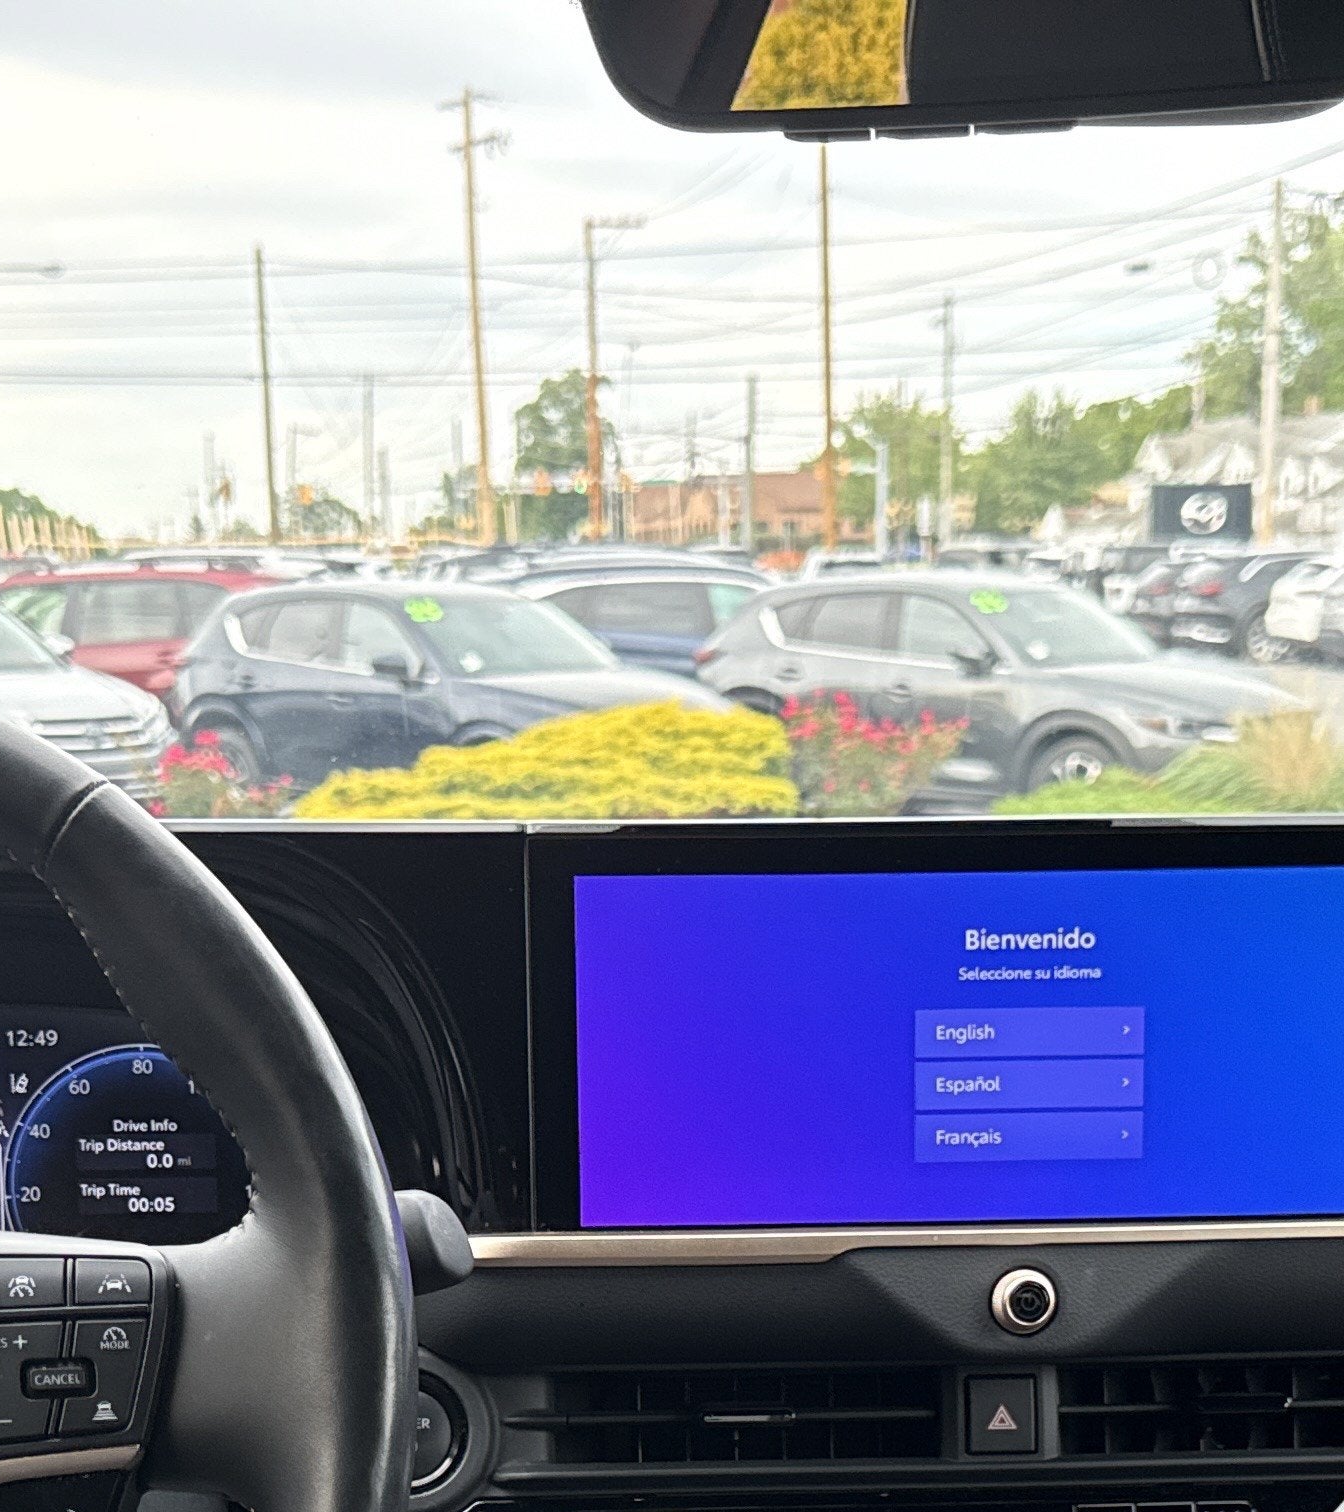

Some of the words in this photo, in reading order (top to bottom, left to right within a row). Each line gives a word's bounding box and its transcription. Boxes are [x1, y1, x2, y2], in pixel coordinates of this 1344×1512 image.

[965, 927, 1096, 951] Bienvenido
[958, 967, 1032, 981] Seleccione
[1035, 969, 1050, 980] su
[1053, 966, 1102, 980] idioma
[6, 1029, 58, 1047] 12:49
[936, 1024, 995, 1045] English
[132, 1059, 153, 1075] 80
[69, 1080, 91, 1095] 60
[936, 1076, 1001, 1096] Español
[29, 1124, 51, 1139] 40
[113, 1120, 148, 1132] Drive
[151, 1119, 178, 1132] Info
[79, 1139, 104, 1154] Trip
[106, 1138, 165, 1151] Distance
[936, 1129, 1002, 1148] Français
[146, 1154, 174, 1169] 0.0
[177, 1156, 192, 1166] mi
[20, 1186, 41, 1202] 20
[80, 1183, 106, 1197] Trip
[108, 1183, 141, 1196] Time
[128, 1197, 175, 1213] 00:05
[99, 1340, 130, 1350] MODE
[34, 1373, 81, 1386] CANCEL
